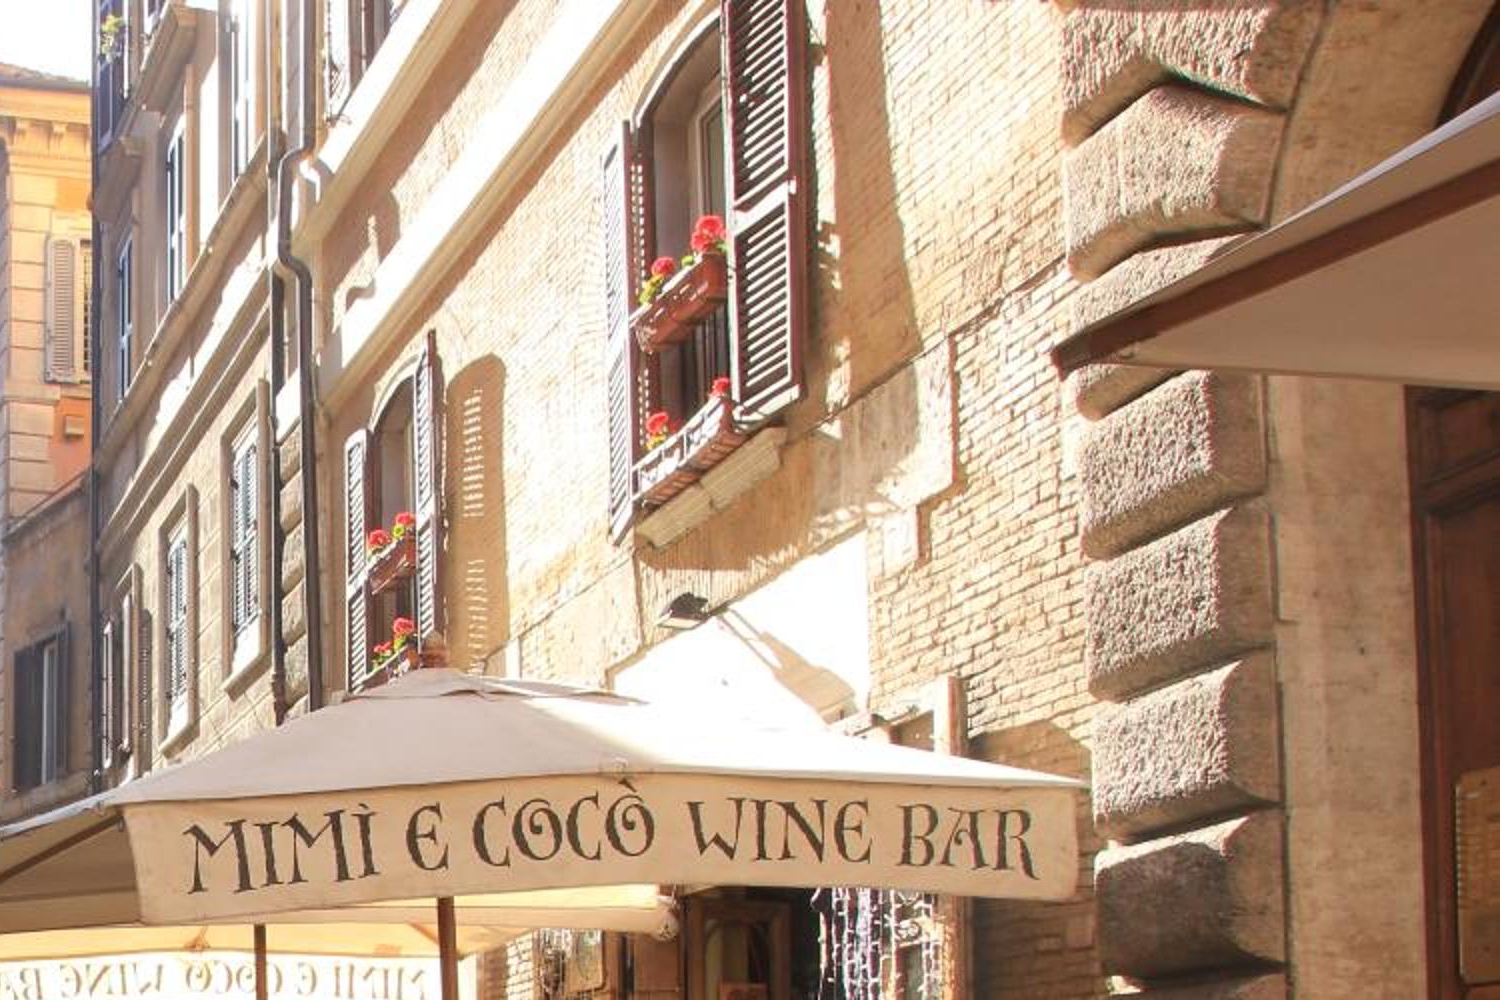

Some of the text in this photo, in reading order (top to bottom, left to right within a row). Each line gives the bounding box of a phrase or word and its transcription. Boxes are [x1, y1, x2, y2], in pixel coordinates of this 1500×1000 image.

[182, 777, 1041, 895] MIMÌ E COCÒ WINE BAR
